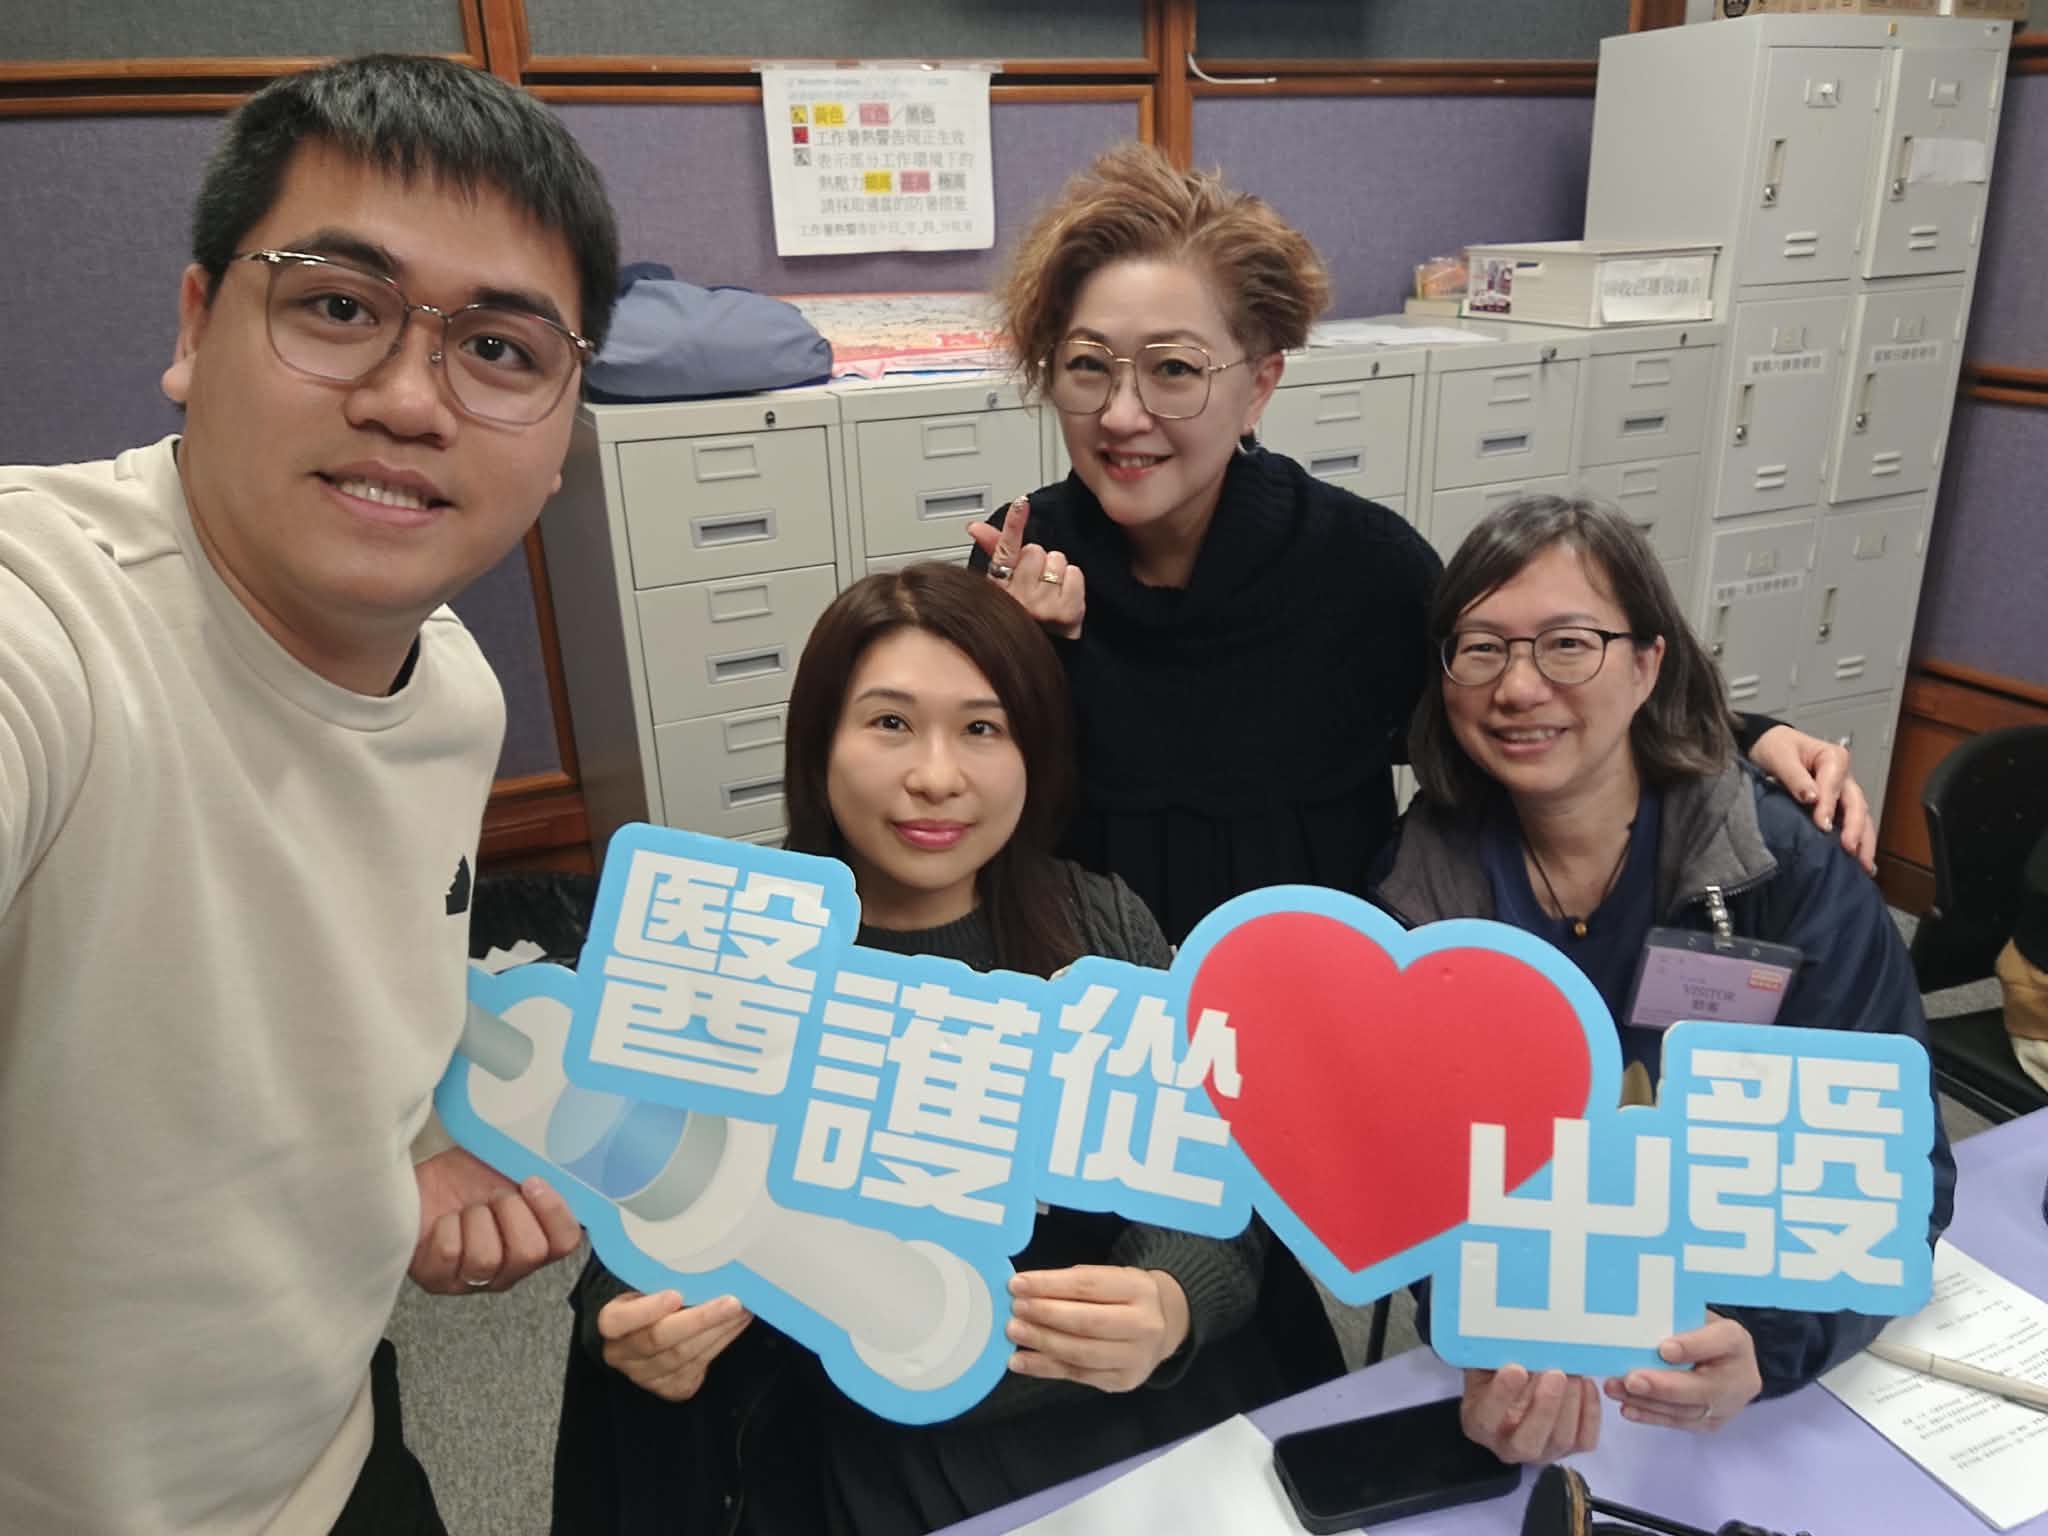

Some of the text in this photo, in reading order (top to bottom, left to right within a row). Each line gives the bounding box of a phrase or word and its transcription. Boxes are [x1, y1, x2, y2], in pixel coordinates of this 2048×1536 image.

[589, 849, 1904, 1348] 醫護從 出發
